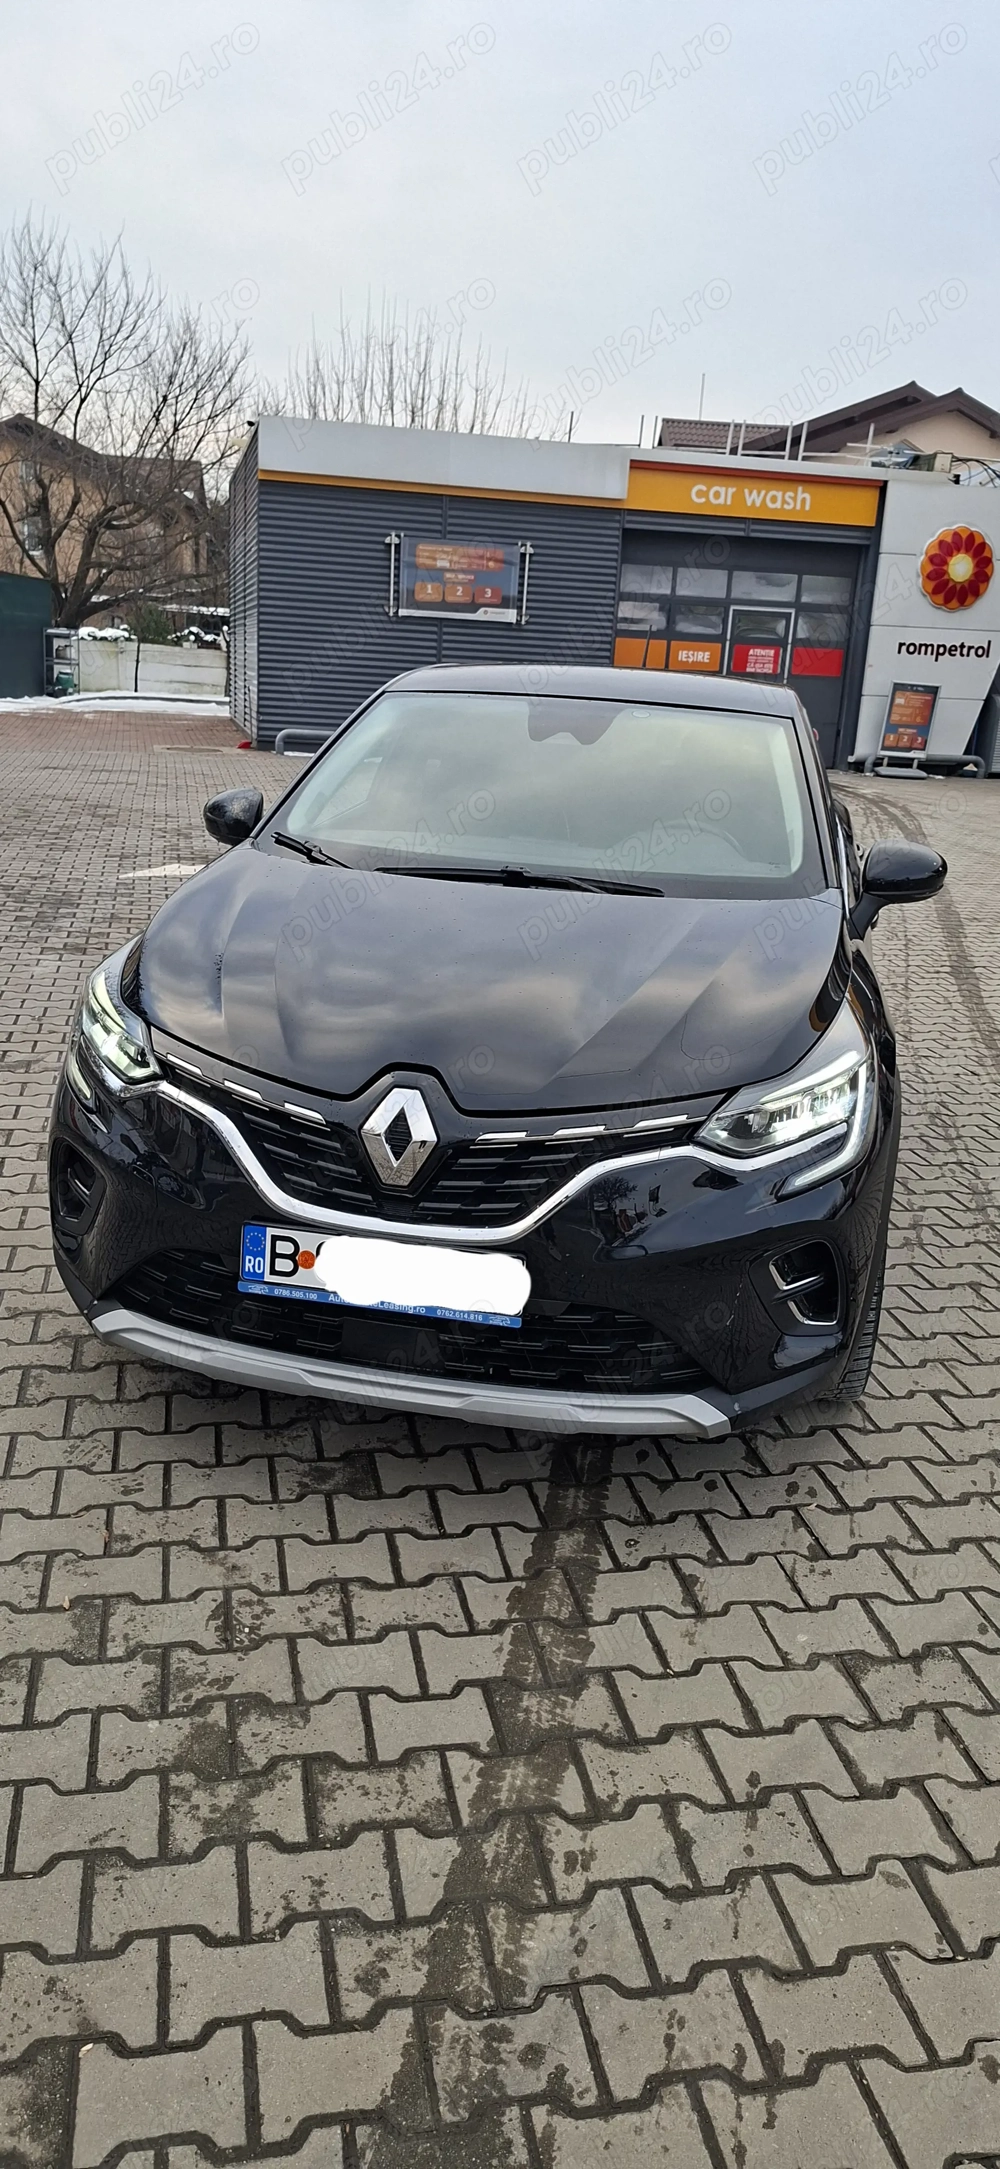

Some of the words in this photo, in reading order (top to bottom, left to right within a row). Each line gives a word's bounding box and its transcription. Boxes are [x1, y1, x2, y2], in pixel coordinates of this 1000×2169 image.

[690, 483, 736, 506] car
[744, 485, 811, 511] wash
[426, 584, 433, 594] 1
[456, 586, 463, 596] 2
[484, 588, 492, 598] 3
[677, 649, 711, 664] IEȘIRE
[896, 640, 992, 663] rompetrol
[245, 1255, 264, 1273] RO
